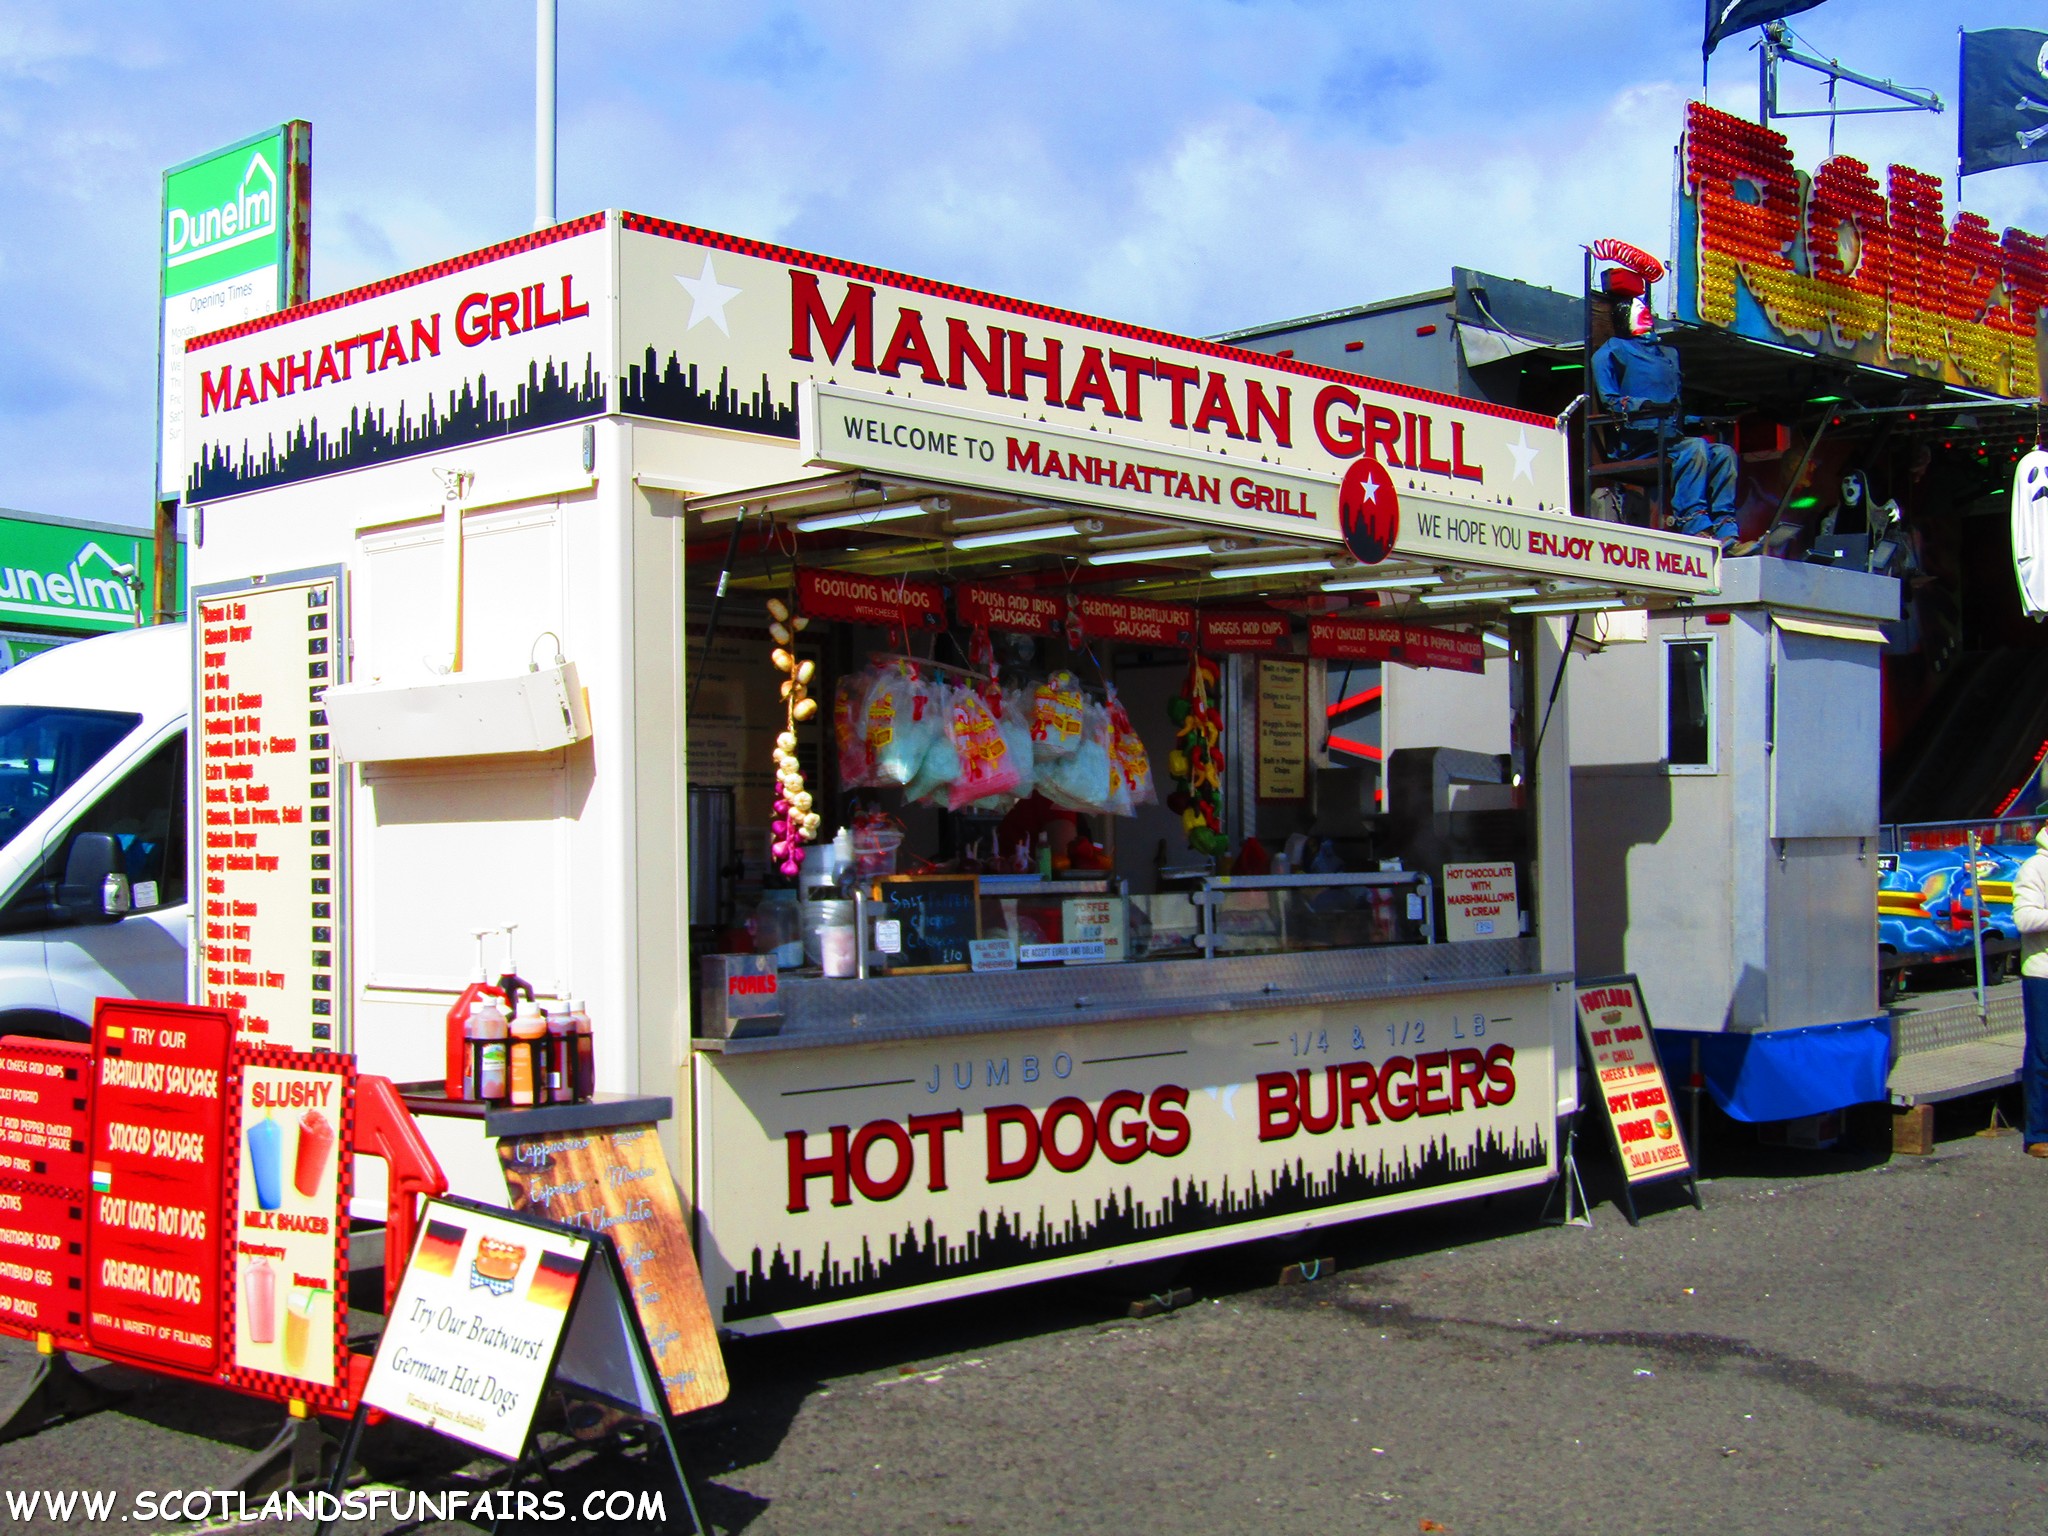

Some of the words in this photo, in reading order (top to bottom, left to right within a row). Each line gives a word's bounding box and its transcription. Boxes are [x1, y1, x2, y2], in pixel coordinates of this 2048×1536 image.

[167, 181, 270, 255] Dunelm
[189, 290, 225, 313] Opening
[228, 282, 253, 301] Times
[200, 313, 442, 418] MANHATTAN
[454, 274, 589, 346] GRILL
[787, 268, 1292, 448] MANHATTAN
[1313, 384, 1483, 484] GRILL
[843, 415, 958, 456] WELCOME
[964, 437, 995, 462] TO
[1006, 436, 1221, 503] MANHATTAN
[1230, 476, 1317, 520] GRILL
[1416, 513, 1442, 539] WE
[1446, 515, 1486, 545] HOPE
[1490, 523, 1522, 550] YOU
[1527, 531, 1592, 560] ENJOY
[1598, 541, 1650, 569] YOUR
[1655, 551, 1708, 578] MEAL
[814, 577, 877, 602] FOOTLONG
[971, 589, 1005, 607] POLISH
[1007, 595, 1030, 610] AND
[1032, 597, 1056, 615] IRISH
[855, 605, 874, 616] WITH
[874, 607, 899, 619] CHEESE
[988, 609, 1041, 629] SAUSAGES
[1081, 600, 1127, 619] GERMAN
[1130, 606, 1190, 626] BRATWURST
[1113, 620, 1162, 639] SAUSAGE
[1209, 621, 1241, 635] HAGGIS
[1242, 621, 1259, 634] AND
[1263, 621, 1284, 635] CHIPS
[1311, 625, 1334, 639] SPICY
[1337, 626, 1366, 641] CHICKEN
[1368, 627, 1400, 642] BURGER
[1404, 631, 1420, 645] SALT
[1430, 636, 1455, 652] PEPPER
[1446, 869, 1464, 879] HOT
[1465, 867, 1513, 879] CHOCOLATE
[1447, 892, 1515, 905] MARSHMALLOWS
[1471, 881, 1491, 891] WITH
[1074, 902, 1110, 912] TOFFEE
[1074, 914, 1110, 925] APPLES
[1464, 907, 1471, 917] &
[1472, 905, 1500, 916] CREAM
[1022, 949, 1030, 958] WE
[1031, 948, 1051, 957] ACCEPT
[1052, 947, 1069, 956] EUROS
[1070, 946, 1081, 955] AND
[1082, 945, 1104, 955] DOLLARS
[728, 974, 777, 995] FORKS
[1580, 988, 1633, 1015] FOOTLONG
[131, 1027, 155, 1045] TRY
[159, 1030, 187, 1048] OUR
[1289, 1029, 1329, 1056] 1/4
[1351, 1025, 1366, 1050] &
[1386, 1019, 1425, 1046] 1/2
[1591, 1029, 1612, 1047] HOT
[1614, 1025, 1644, 1043] DOGS
[6, 1058, 28, 1073] CHEESE
[28, 1062, 44, 1075] AND
[45, 1063, 65, 1078] CHIPS
[102, 1057, 165, 1093] BRATWURST
[166, 1065, 218, 1099] SAUSAGE
[926, 1052, 1073, 1093] JUMBO
[1600, 1067, 1627, 1083] CHEESE
[13, 1089, 39, 1104] POTATO
[252, 1081, 333, 1108] SLUSHY
[1256, 1043, 1516, 1142] BURGERS
[1607, 1092, 1632, 1115] SPICY
[1631, 1087, 1666, 1110] CHICKEN
[4, 1117, 19, 1130] AND
[20, 1120, 45, 1135] PEPPER
[46, 1124, 72, 1138] CHICKEN
[1617, 1118, 1656, 1145] BURGER
[8, 1130, 23, 1143] AND
[24, 1133, 47, 1148] CURRY
[47, 1136, 71, 1151] SAUCE
[109, 1122, 151, 1154] SMOKED
[152, 1128, 204, 1163] SAUSAGE
[516, 1137, 590, 1166] Cappuccino
[785, 1109, 963, 1213] HOT
[983, 1084, 1191, 1184] DOGS
[13, 1157, 31, 1172] FRIES
[1630, 1152, 1652, 1169] SALAD
[1659, 1143, 1682, 1162] CHEESE
[529, 1175, 588, 1207] Espresso
[604, 1157, 656, 1190] Mocha
[100, 1195, 127, 1226] FOOT
[128, 1200, 156, 1232] LONG
[158, 1205, 180, 1235] HOT
[180, 1208, 206, 1240] DOG
[244, 1210, 275, 1230] MILK
[277, 1212, 329, 1235] SHAKES
[591, 1197, 653, 1232] Chocolate
[36, 1233, 61, 1251] SOUP
[238, 1240, 287, 1261] Strawberry
[34, 1267, 53, 1286] EGG
[102, 1258, 151, 1295] ORIGINAL
[153, 1267, 175, 1298] HOT
[175, 1271, 201, 1305] DOG
[292, 1272, 328, 1290] Banana
[13, 1298, 38, 1319] ROLLS
[91, 1312, 113, 1328] WITH
[114, 1317, 121, 1329] A
[122, 1318, 157, 1338] VARIETY
[158, 1327, 172, 1341] OF
[173, 1330, 213, 1349] FILLINGS
[409, 1296, 436, 1333] Try
[437, 1306, 467, 1336] Our
[466, 1315, 544, 1361] Bratwurst
[392, 1346, 449, 1386] German
[448, 1365, 481, 1397] Hot
[479, 1375, 519, 1417] Dogs
